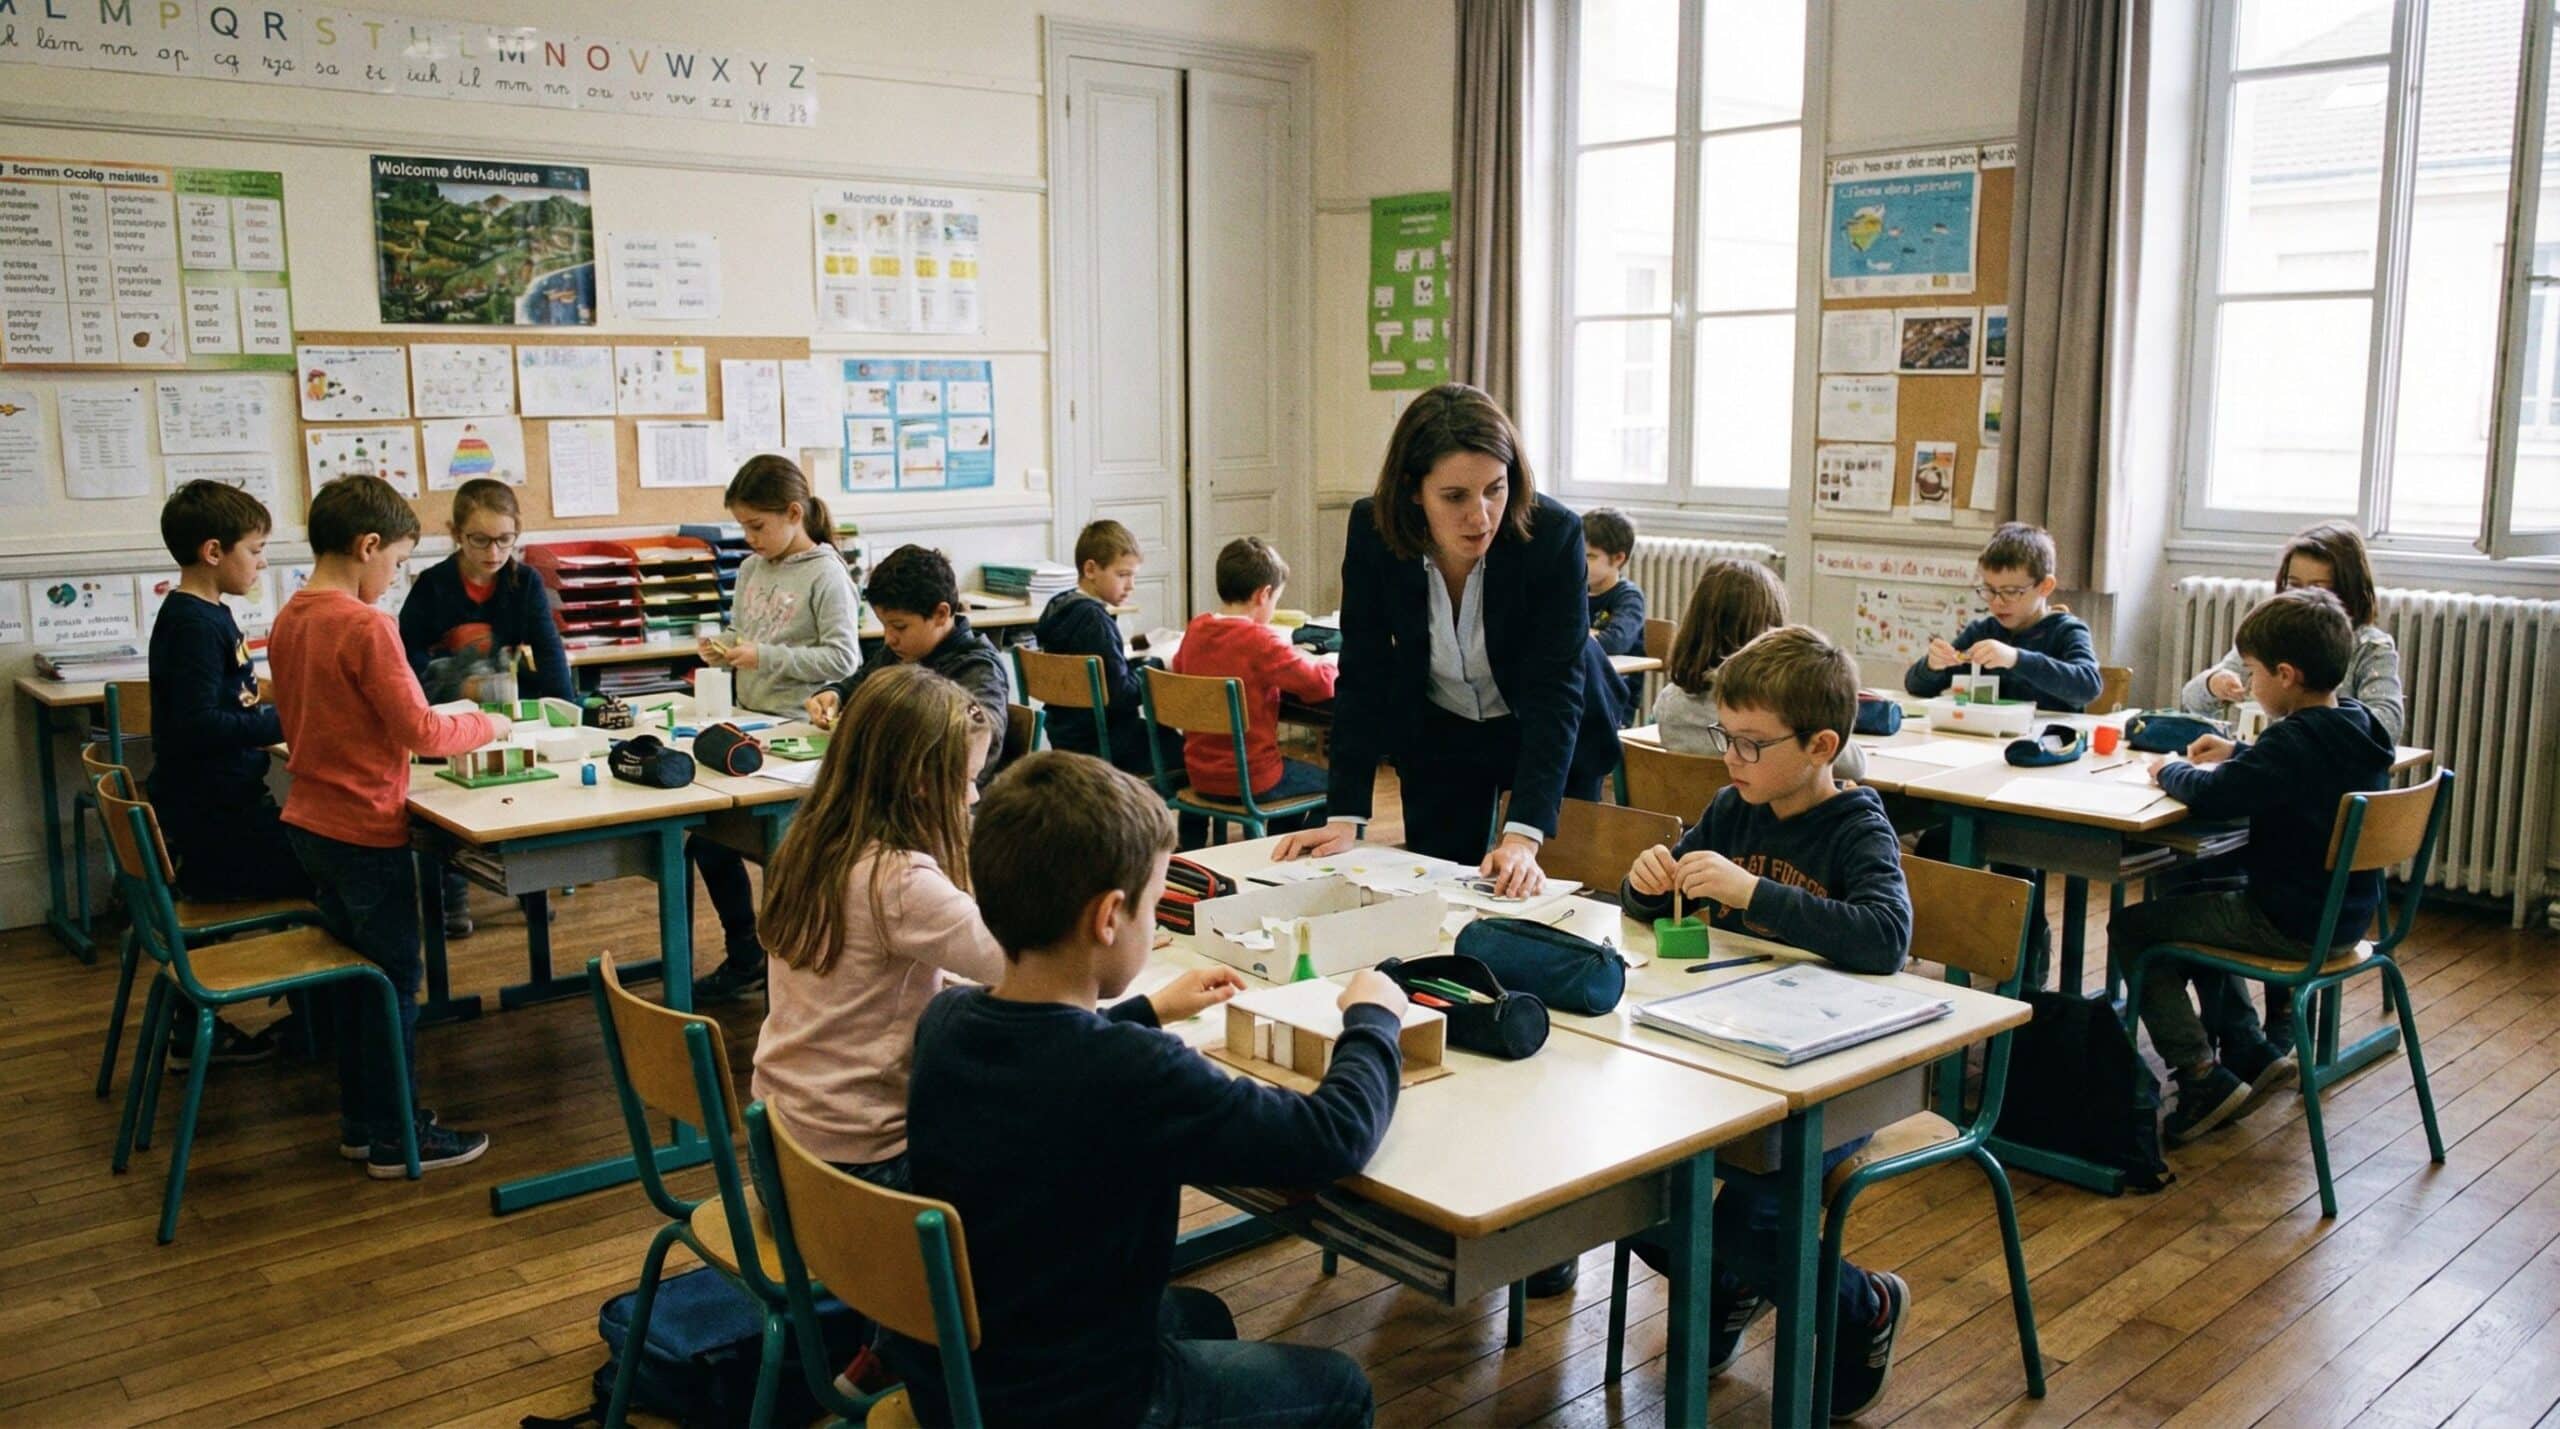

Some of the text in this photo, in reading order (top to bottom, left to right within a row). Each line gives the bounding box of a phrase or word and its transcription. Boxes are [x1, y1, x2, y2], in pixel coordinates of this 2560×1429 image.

[101, 0, 132, 26] M
[160, 1, 182, 29] P
[210, 7, 240, 39] Q
[264, 11, 287, 41] R
[315, 17, 337, 46] S
[363, 22, 385, 49] T
[545, 41, 566, 67] N
[587, 45, 611, 71] O
[629, 48, 650, 75] V
[666, 52, 695, 79] W
[711, 57, 731, 83] X
[750, 61, 768, 86] Y
[788, 65, 805, 89] Z
